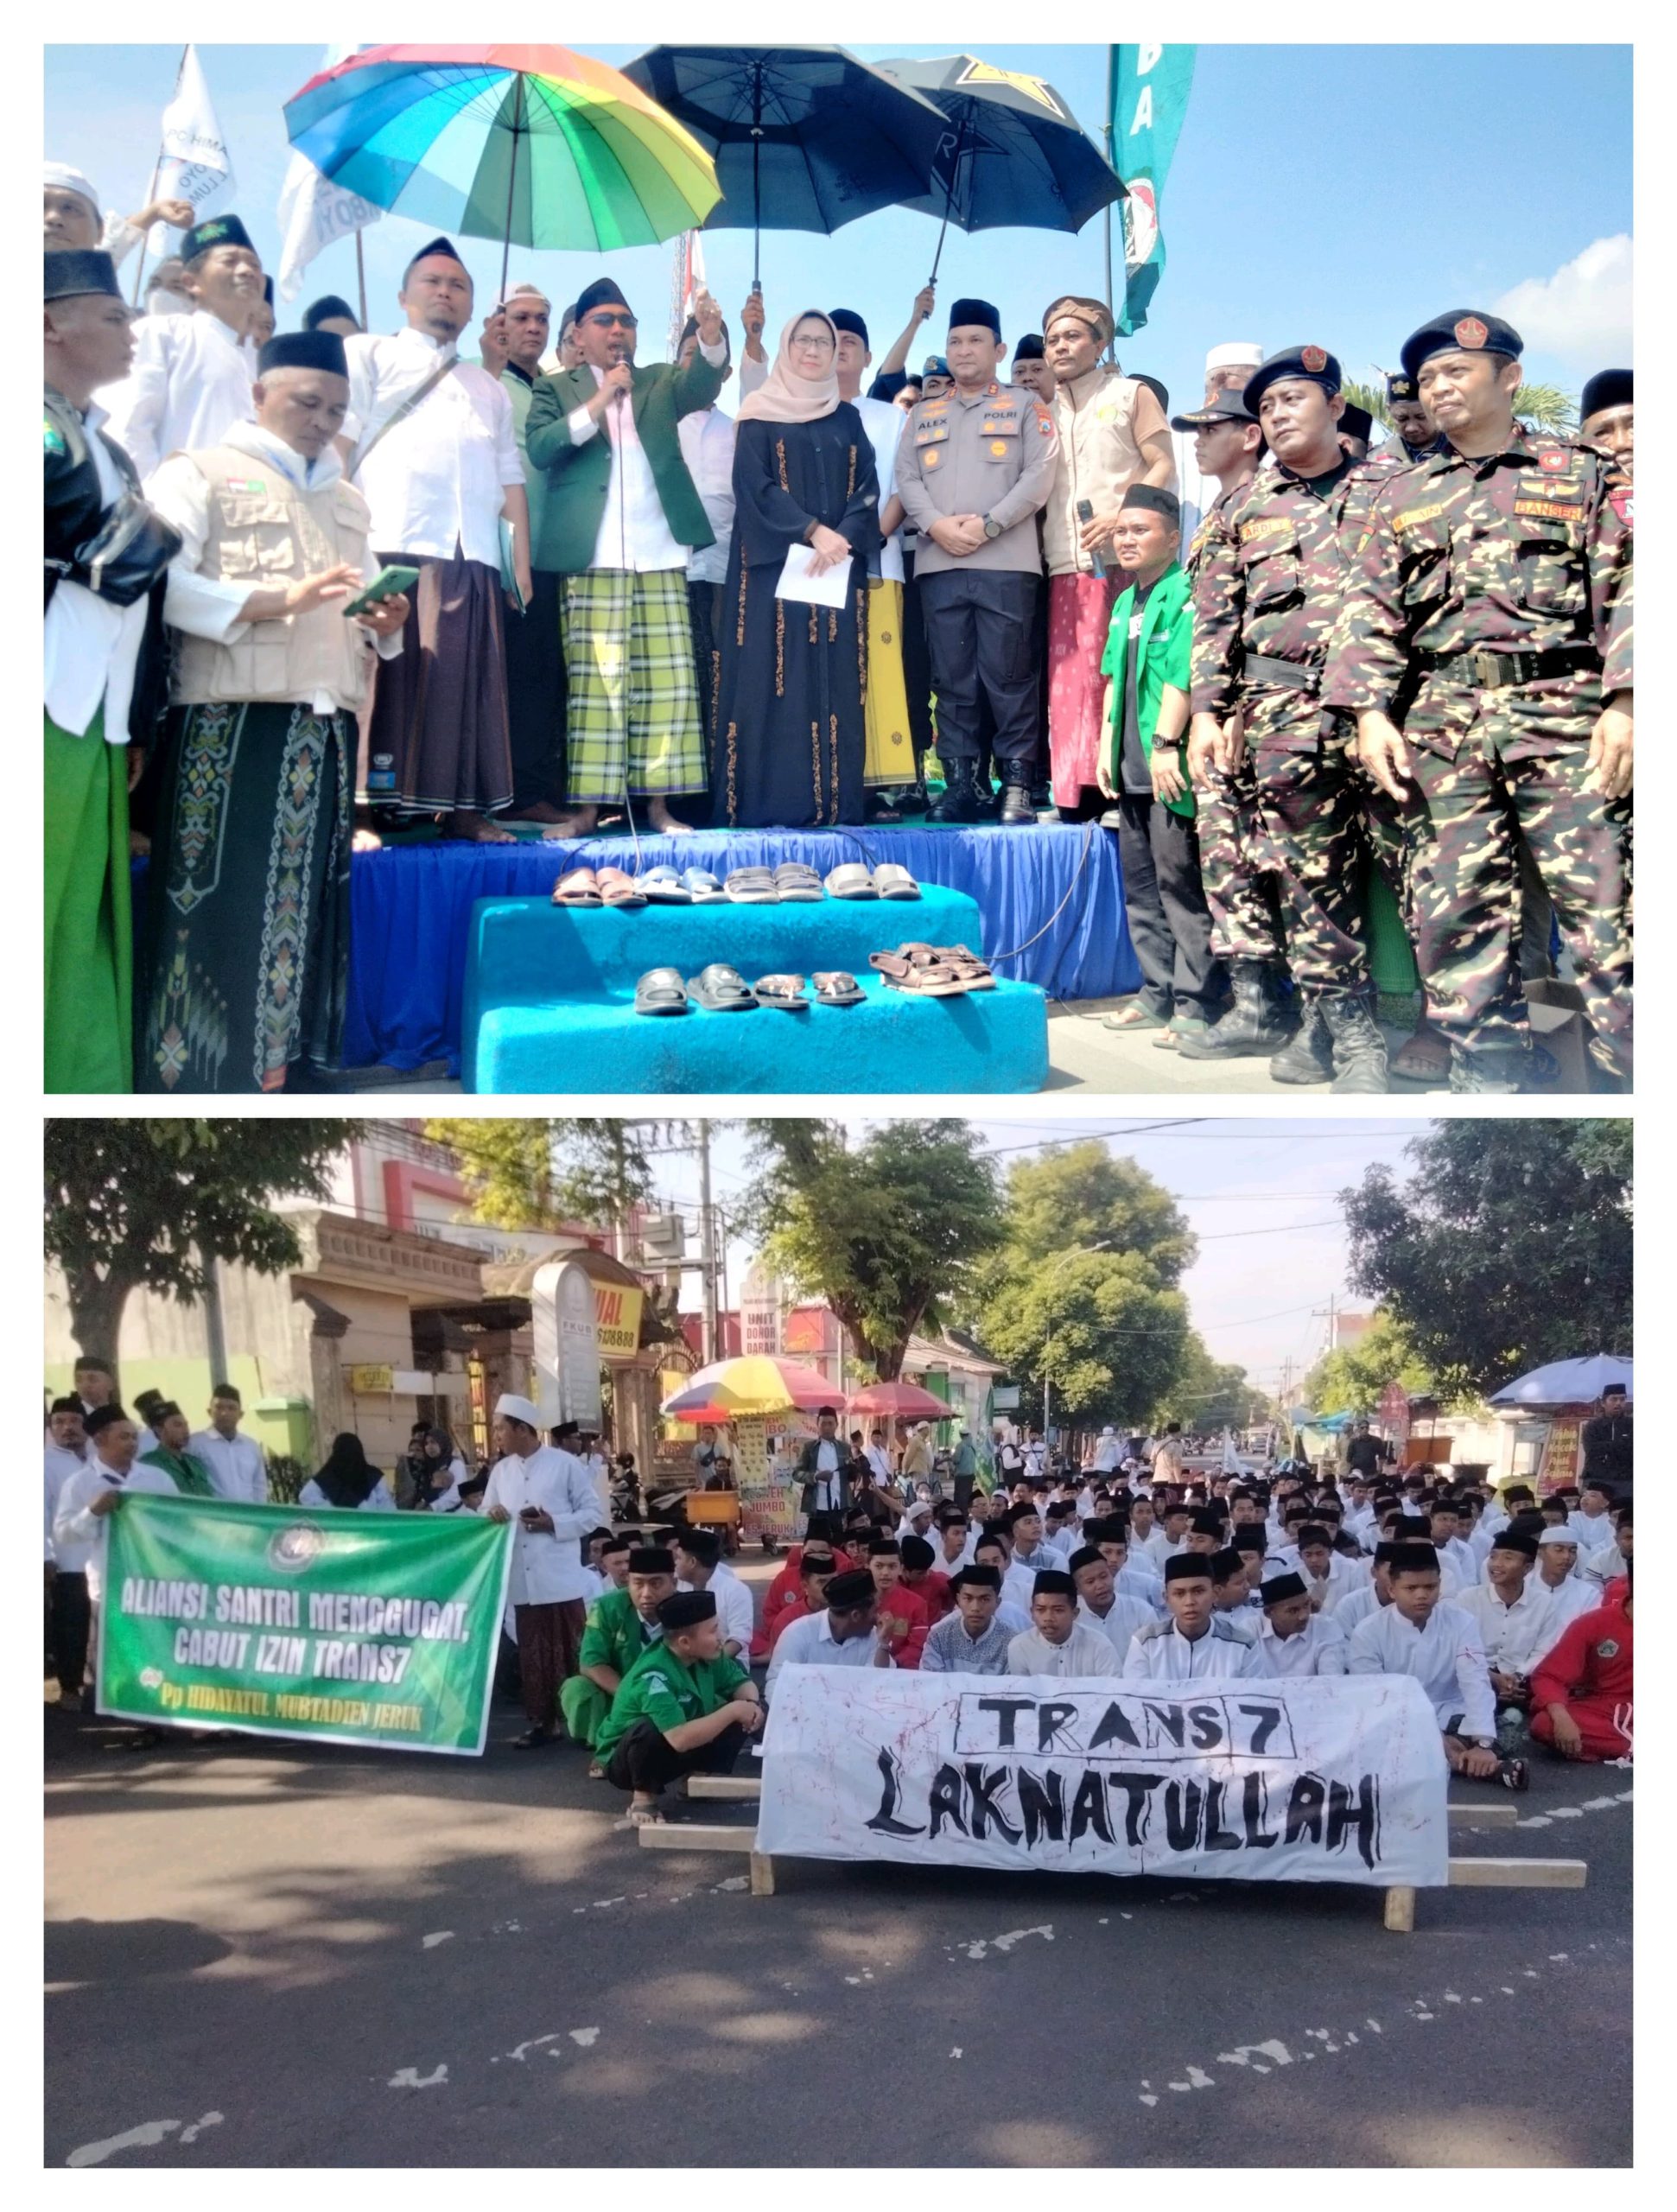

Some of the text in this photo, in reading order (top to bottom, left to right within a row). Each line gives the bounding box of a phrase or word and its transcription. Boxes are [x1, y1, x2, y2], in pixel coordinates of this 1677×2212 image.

[983, 411, 1018, 420] POLRI
[918, 418, 948, 430] ALEX
[1517, 500, 1581, 520] BANSER
[747, 1313, 774, 1325] UNIT
[562, 1320, 593, 1334] FKUB
[746, 1326, 776, 1339] DONOR
[746, 1342, 776, 1355] DARAH
[749, 1501, 785, 1512] JUMBO
[121, 1577, 469, 1642] ALIANSI SANTRI MENGGUGAT,
[174, 1626, 412, 1684] CABUT IZIN TRANS7
[187, 1683, 269, 1717] HIDAYATUL
[371, 1702, 423, 1732] JERUK
[978, 1699, 1281, 1755] TRANS 7
[864, 1745, 1382, 1872] LAKNATULLAH
